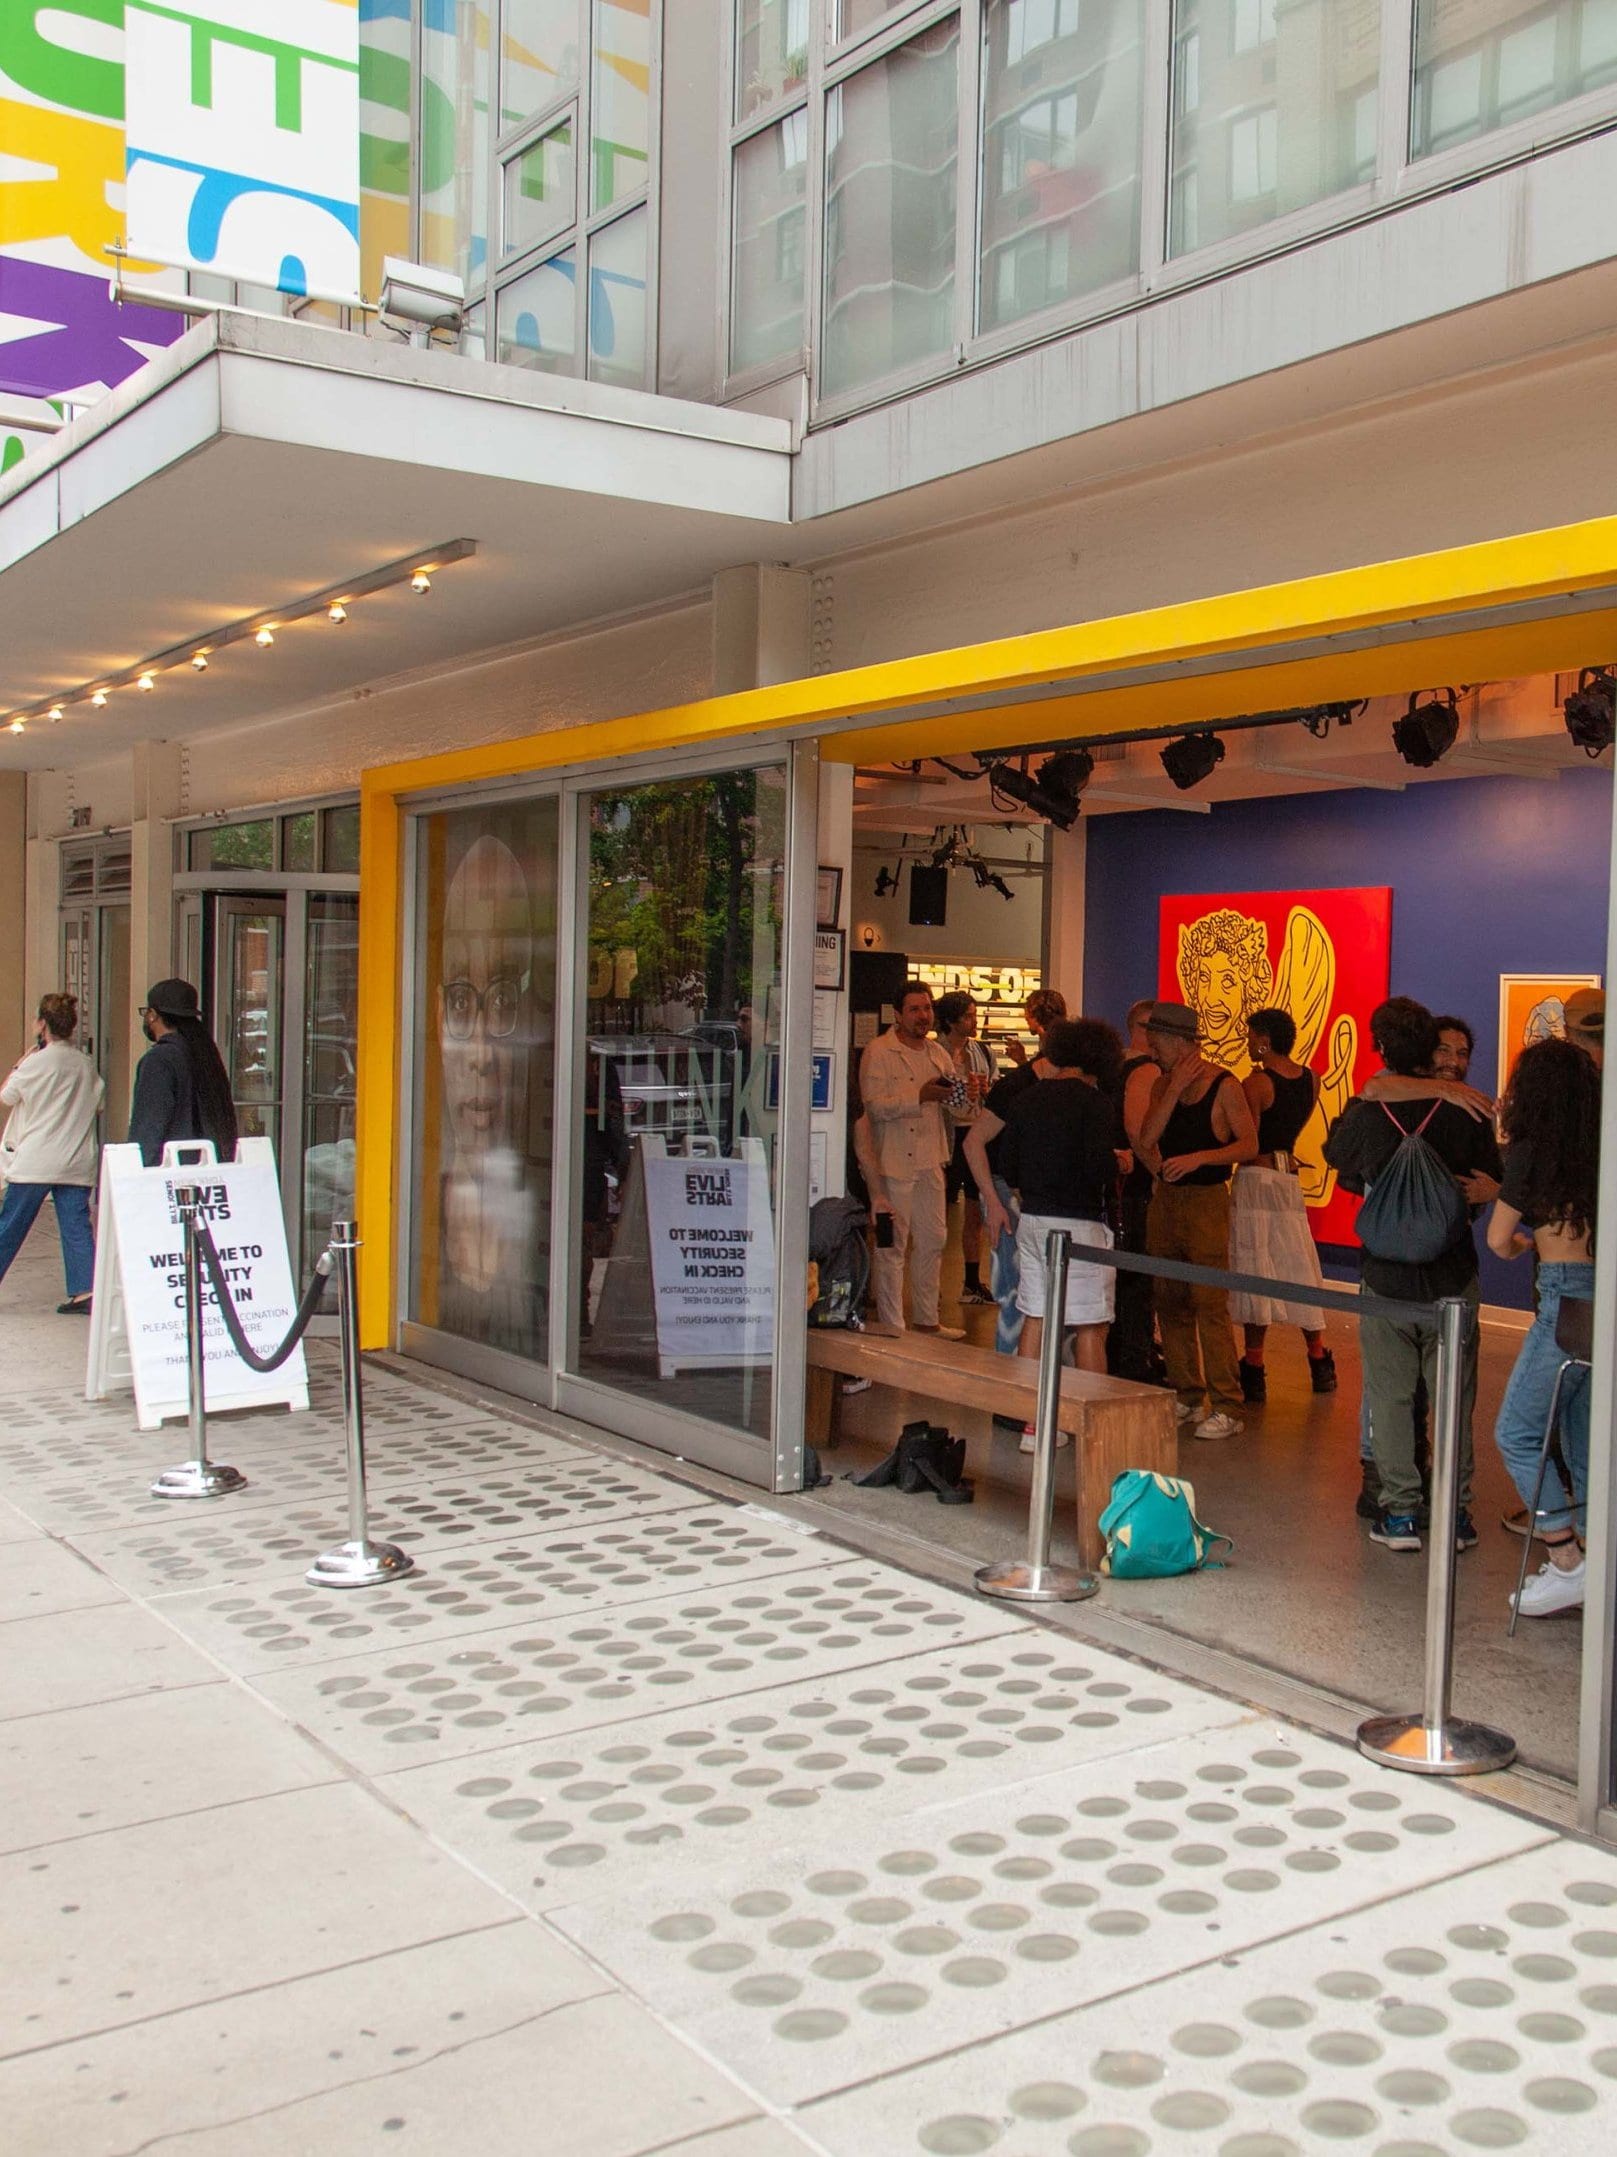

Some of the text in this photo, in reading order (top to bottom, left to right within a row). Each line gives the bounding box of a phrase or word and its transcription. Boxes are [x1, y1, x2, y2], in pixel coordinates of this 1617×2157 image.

[149, 1244, 263, 1269] WELME TO
[167, 1266, 253, 1288] SEUITY
[174, 1287, 253, 1309] CEC IN
[142, 1320, 181, 1333] PLEASE
[236, 1308, 289, 1323] CCINATION
[201, 1326, 225, 1338] ALID
